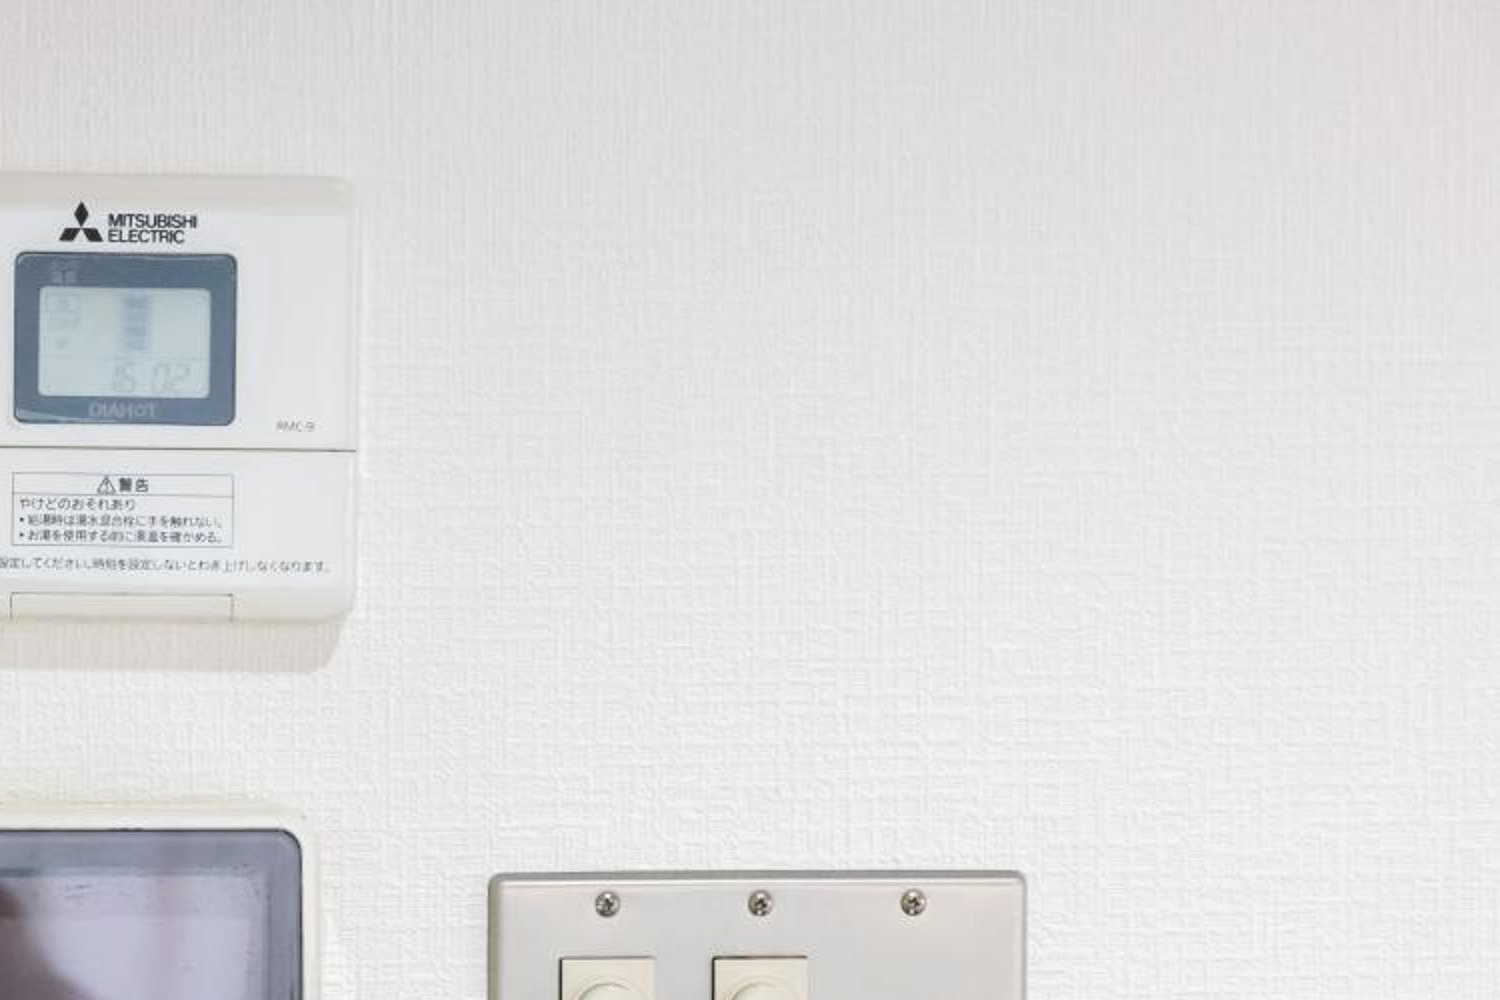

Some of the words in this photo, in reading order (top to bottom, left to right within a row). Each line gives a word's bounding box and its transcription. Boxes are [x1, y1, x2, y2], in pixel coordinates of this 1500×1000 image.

[108, 213, 197, 229] MITSUBISHI
[108, 229, 185, 244] ELECTRIC
[118, 477, 149, 493] 警告
[19, 498, 136, 511] やけどのおそれあり
